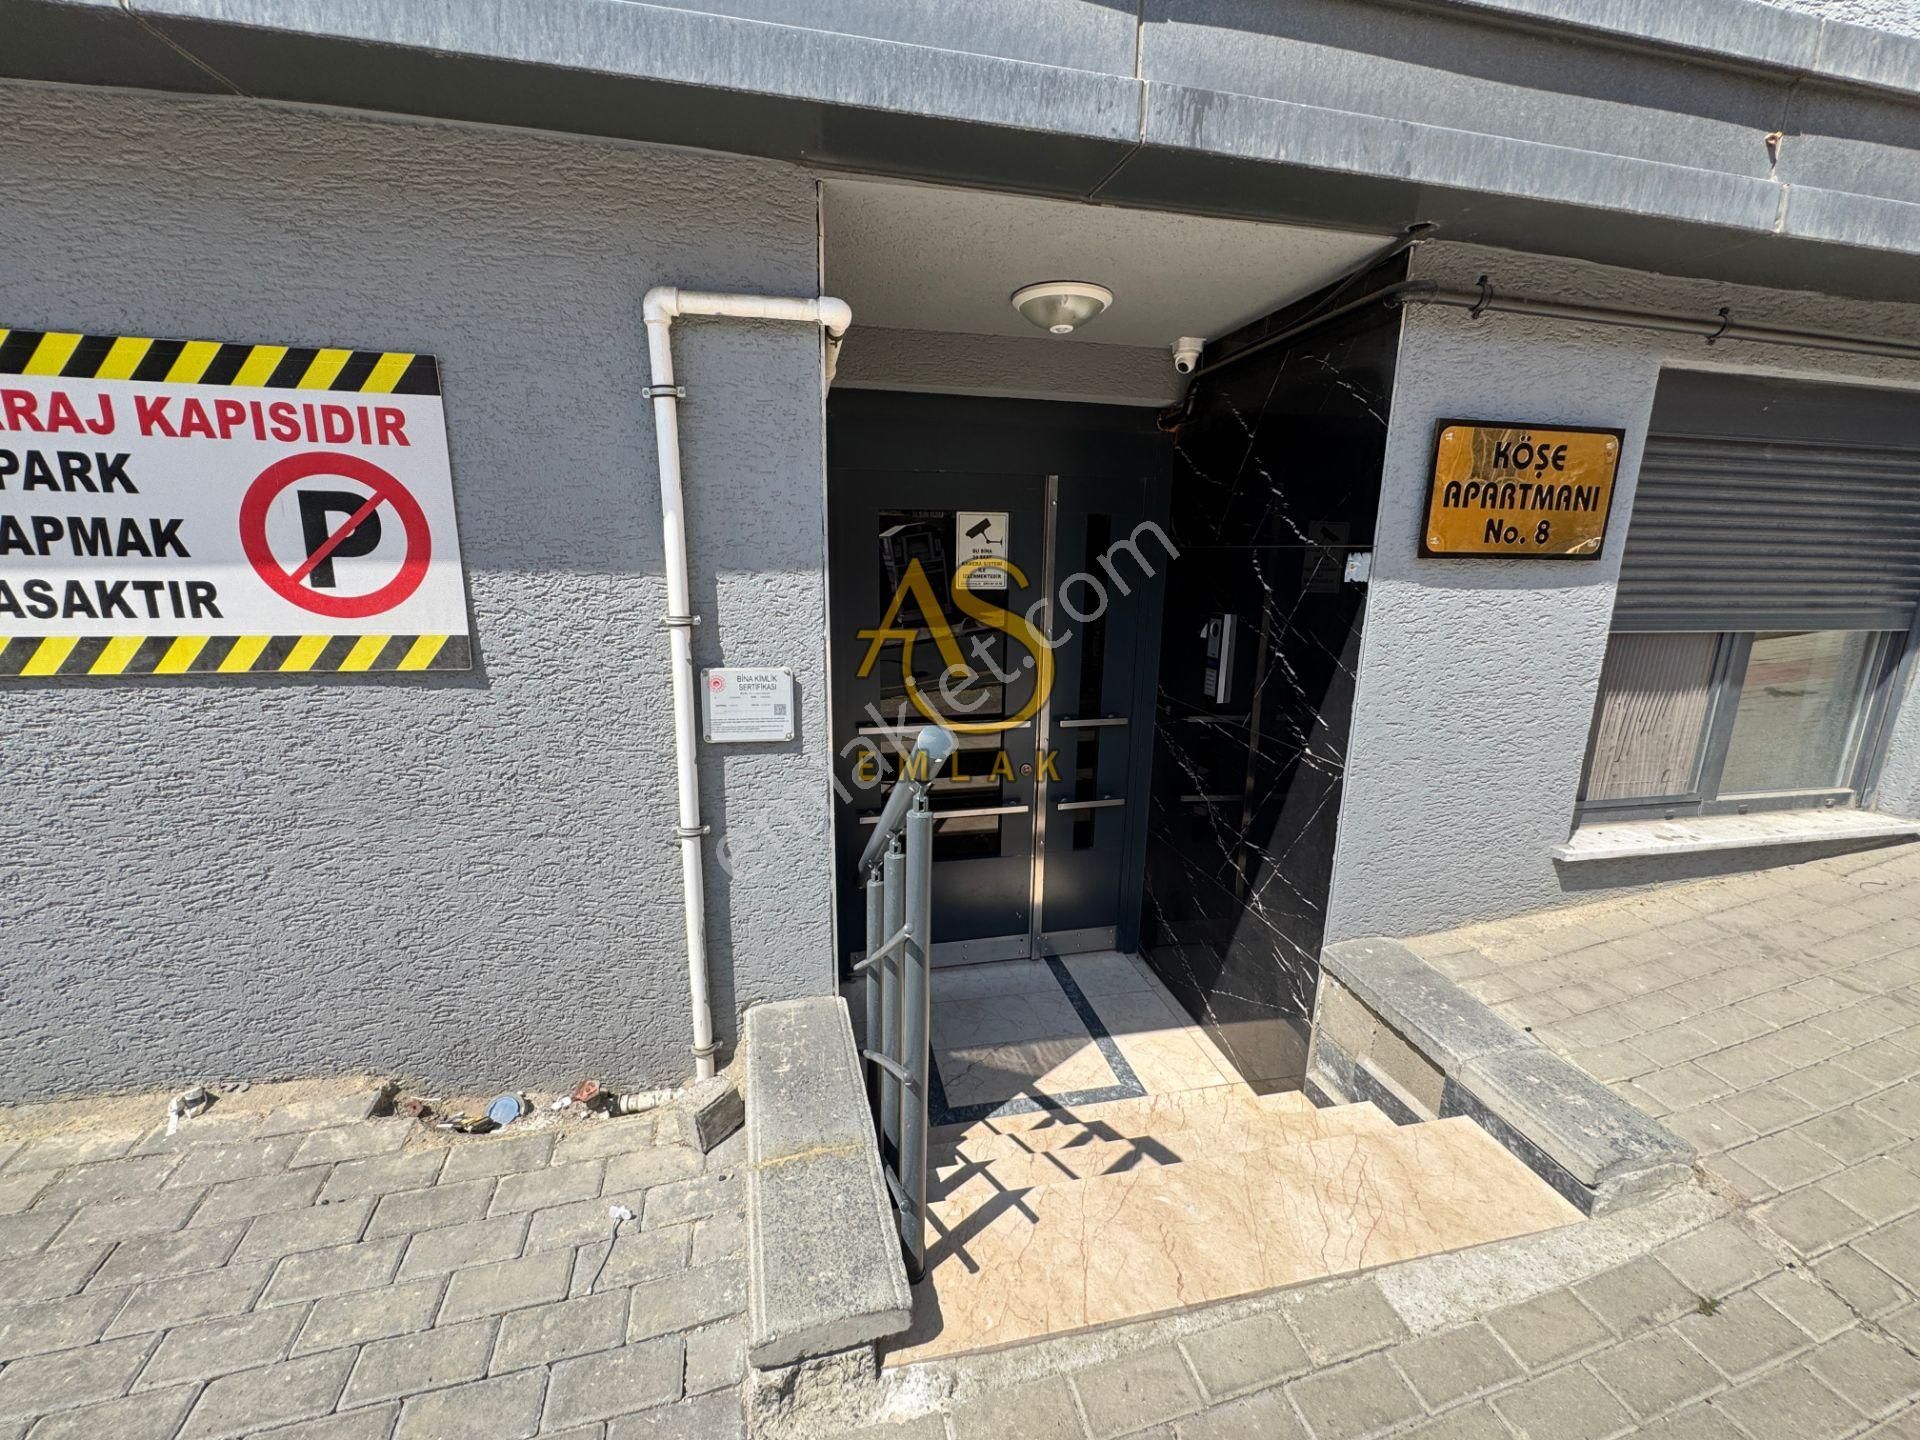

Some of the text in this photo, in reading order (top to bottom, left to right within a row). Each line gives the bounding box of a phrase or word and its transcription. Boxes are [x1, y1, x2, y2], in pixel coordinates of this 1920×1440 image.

[0, 388, 411, 447] RAJ KAPISIDIR
[0, 449, 140, 494] PARK
[1493, 434, 1568, 479] KÖŞE
[1443, 480, 1600, 512] APARTMANI
[1484, 518, 1551, 545] No. 8
[736, 673, 778, 682] BİNA KİMLİK
[738, 682, 777, 691] SERTİFİKASI
